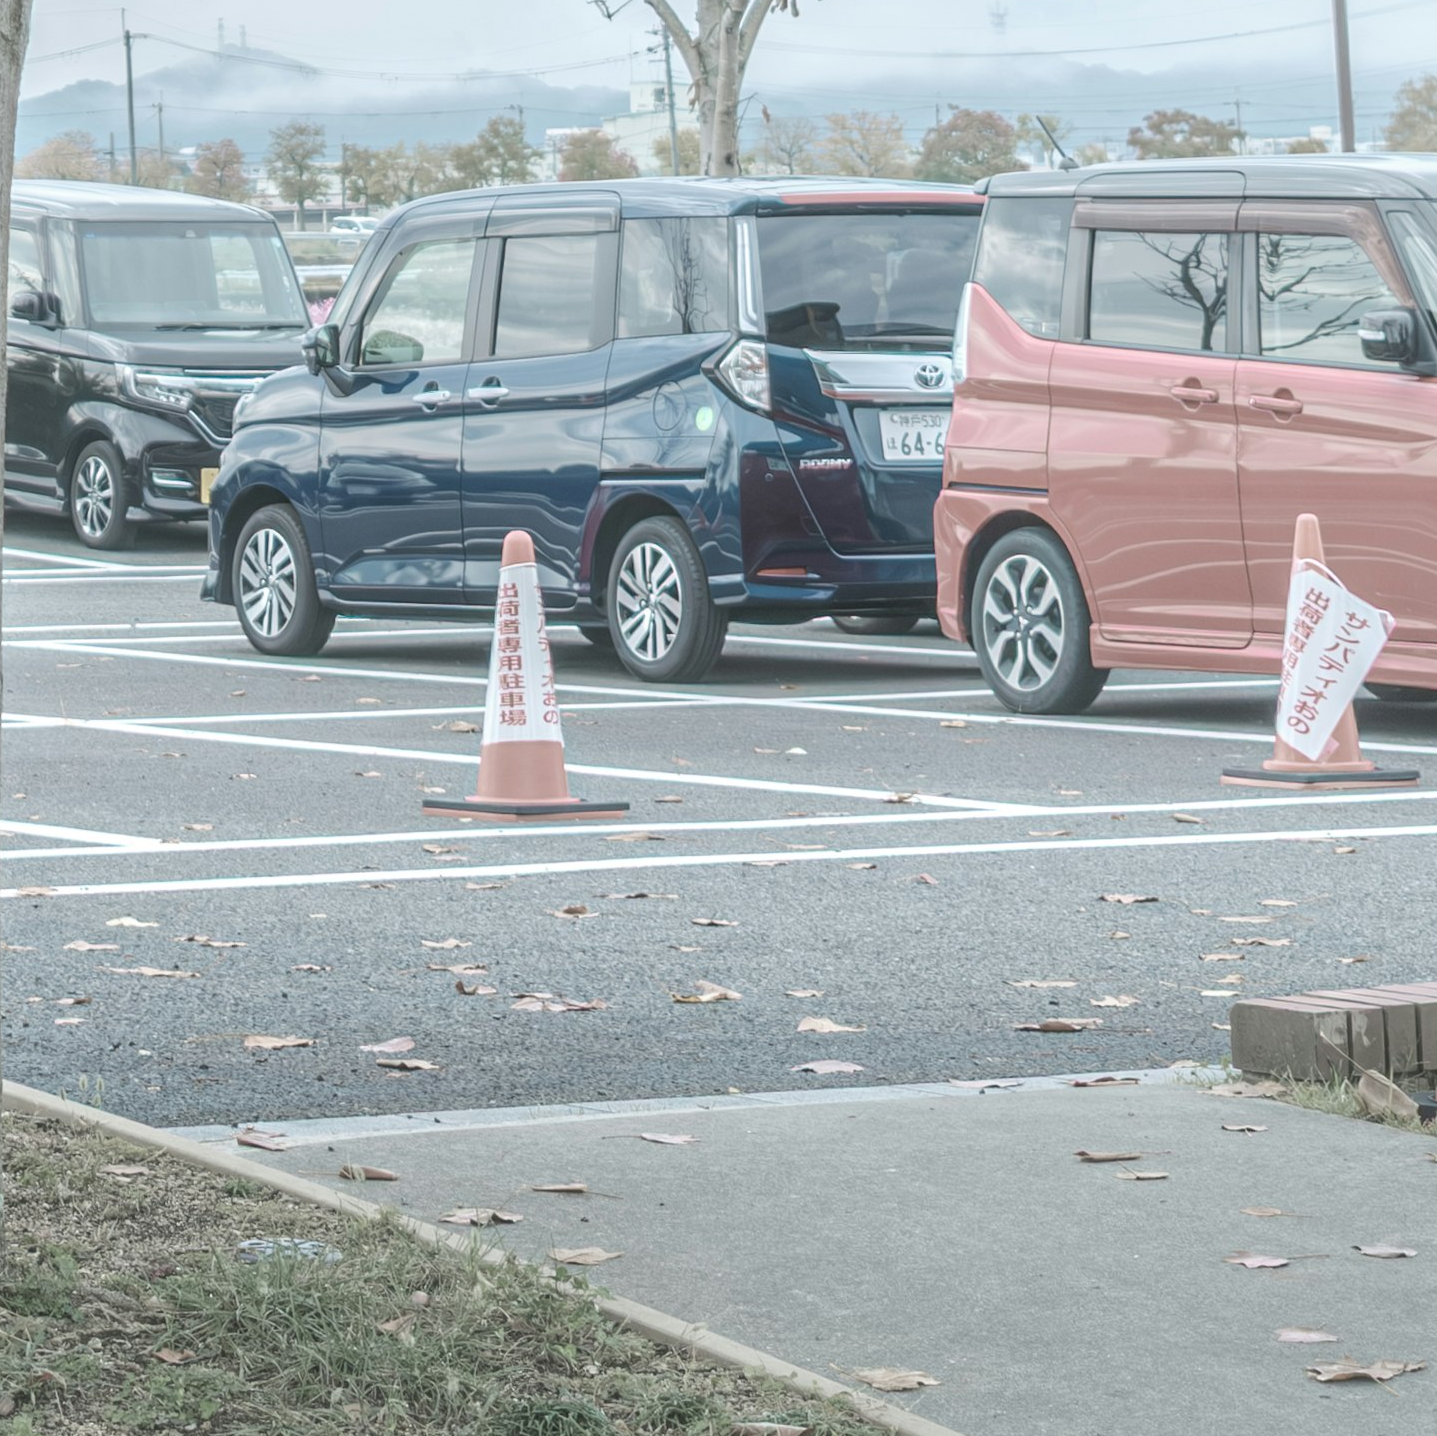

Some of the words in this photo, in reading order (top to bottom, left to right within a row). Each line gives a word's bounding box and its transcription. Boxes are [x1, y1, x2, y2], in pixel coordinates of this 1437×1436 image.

[901, 431, 945, 456] 64-6
[498, 583, 527, 726] 出荷者専用駐車場
[1288, 611, 1371, 735] サンパティオおの
